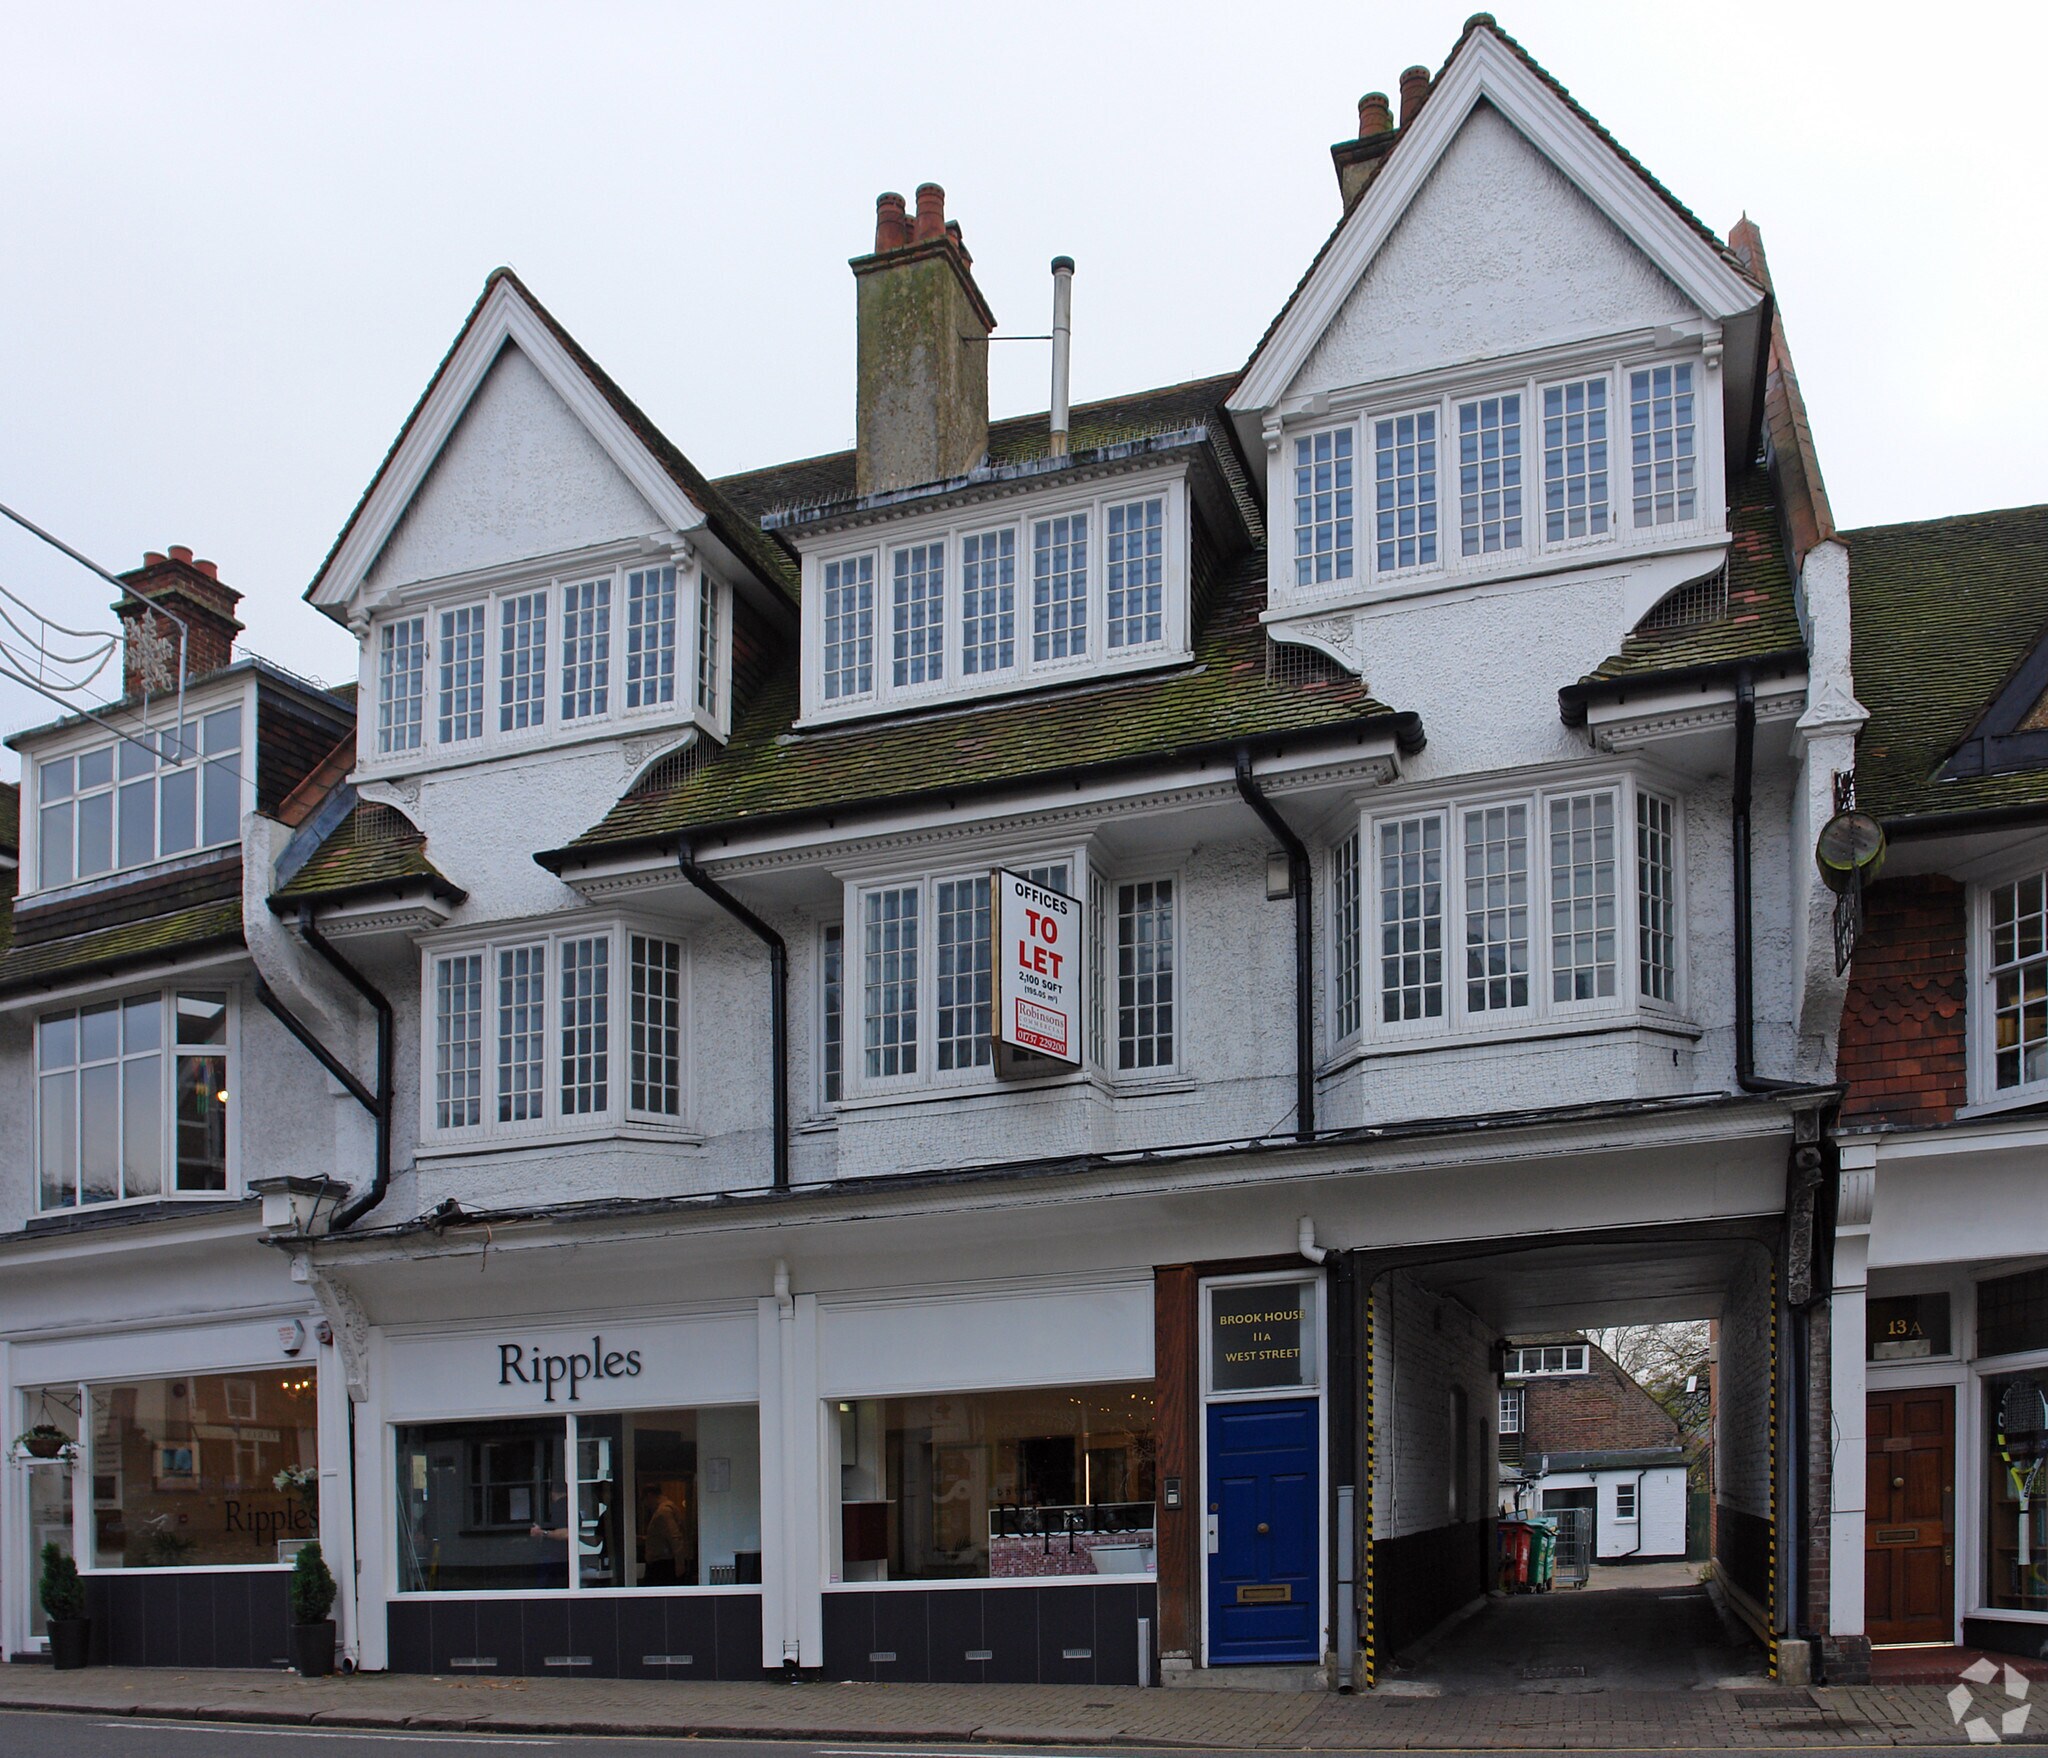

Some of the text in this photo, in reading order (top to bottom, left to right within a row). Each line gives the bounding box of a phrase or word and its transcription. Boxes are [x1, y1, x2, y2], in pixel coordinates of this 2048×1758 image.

[1015, 882, 1067, 915] OFFICES
[1025, 908, 1058, 944] TO
[1019, 940, 1063, 979] LET
[1019, 971, 1063, 994] 2,100 SQFT
[1019, 1002, 1064, 1028] Robinsons
[1220, 1310, 1305, 1325] BROOK HOUSE
[1887, 1319, 1923, 1336] 13A
[498, 1335, 641, 1402] Ripples
[1225, 1348, 1300, 1363] WEST STREET
[225, 1497, 319, 1547] Ripples
[996, 1502, 1139, 1555] Ripples
